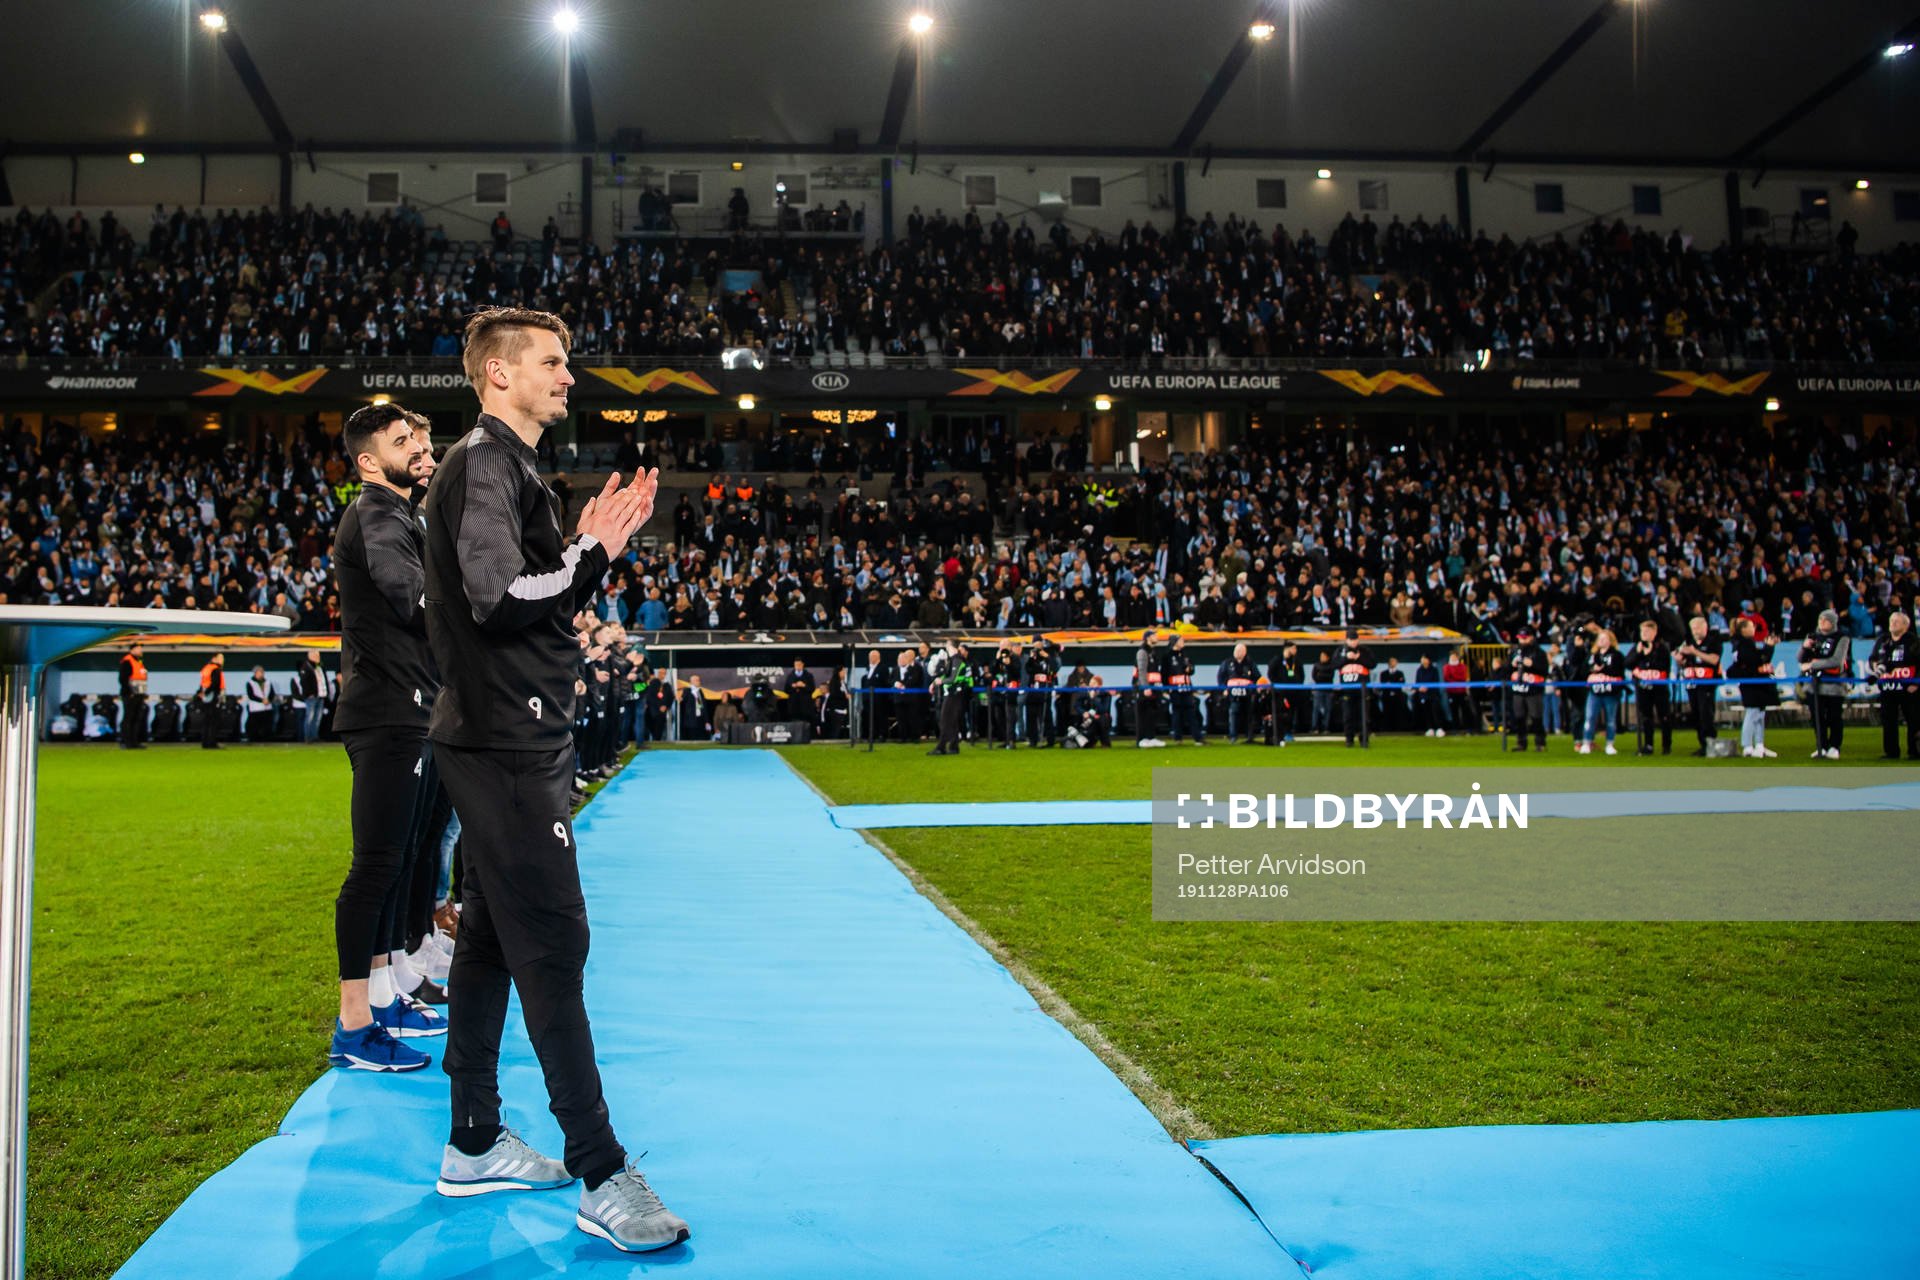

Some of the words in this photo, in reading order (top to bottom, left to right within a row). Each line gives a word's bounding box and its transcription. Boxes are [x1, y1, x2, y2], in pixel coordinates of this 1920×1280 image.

[363, 374, 406, 388] UEFA
[818, 376, 843, 387] KIA
[1109, 375, 1151, 388] UEFA
[1155, 375, 1216, 389] EUROPA
[1220, 375, 1281, 389] LEAGUE
[1798, 378, 1835, 391] UEFA
[1838, 378, 1892, 391] EUROPA
[736, 666, 784, 676] EUROPA
[413, 688, 422, 706] 4
[528, 696, 542, 719] 9
[413, 758, 422, 777] 4
[553, 821, 569, 847] 9
